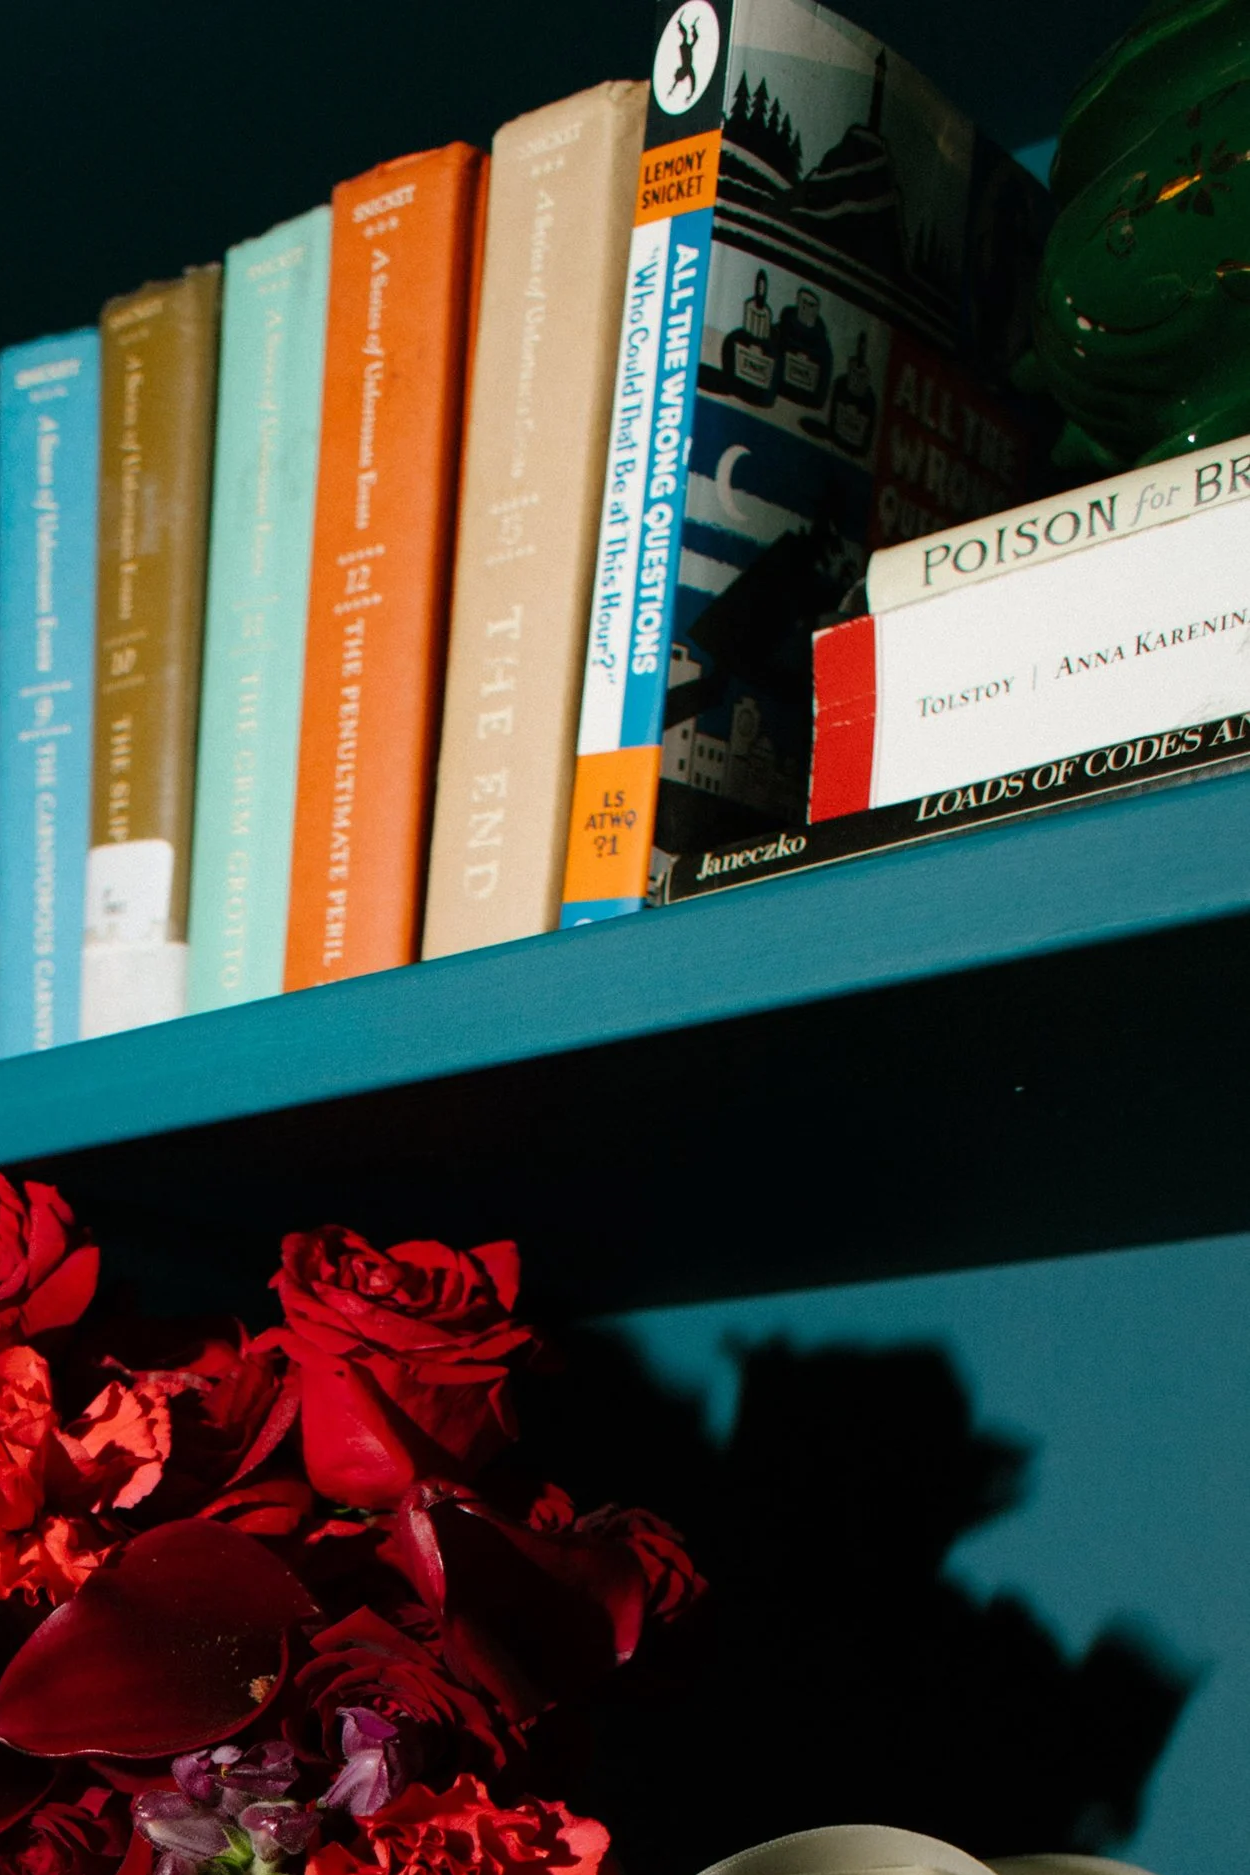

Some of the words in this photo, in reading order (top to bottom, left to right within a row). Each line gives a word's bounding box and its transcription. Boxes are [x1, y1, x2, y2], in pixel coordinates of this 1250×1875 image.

[641, 174, 704, 210] SNICKET
[644, 147, 706, 185] LEMONY
[671, 244, 701, 309] ALL
[620, 327, 654, 398] Could
[662, 306, 692, 369] THE
[615, 403, 644, 455] That
[648, 370, 685, 497] WRONG
[611, 461, 637, 494] Be
[609, 500, 631, 528] at
[921, 492, 1120, 588] POISON
[1127, 481, 1180, 529] for
[599, 530, 628, 587] This
[631, 503, 676, 675] QUESTIONS
[339, 617, 367, 679] THE
[477, 604, 524, 742] THE
[914, 674, 1016, 720] TOLSTOY
[1054, 645, 1125, 680] ANNA
[1134, 605, 1250, 657] KARENIN
[326, 683, 363, 884] PENULTIMATE
[603, 790, 625, 807] LS
[913, 770, 1025, 823] LOADS
[1031, 755, 1078, 791] OF
[1083, 723, 1203, 778] CODES
[459, 765, 513, 900] END
[584, 809, 638, 831] ATWQ
[695, 833, 808, 882] Janeczko
[321, 888, 351, 968] PERIL
